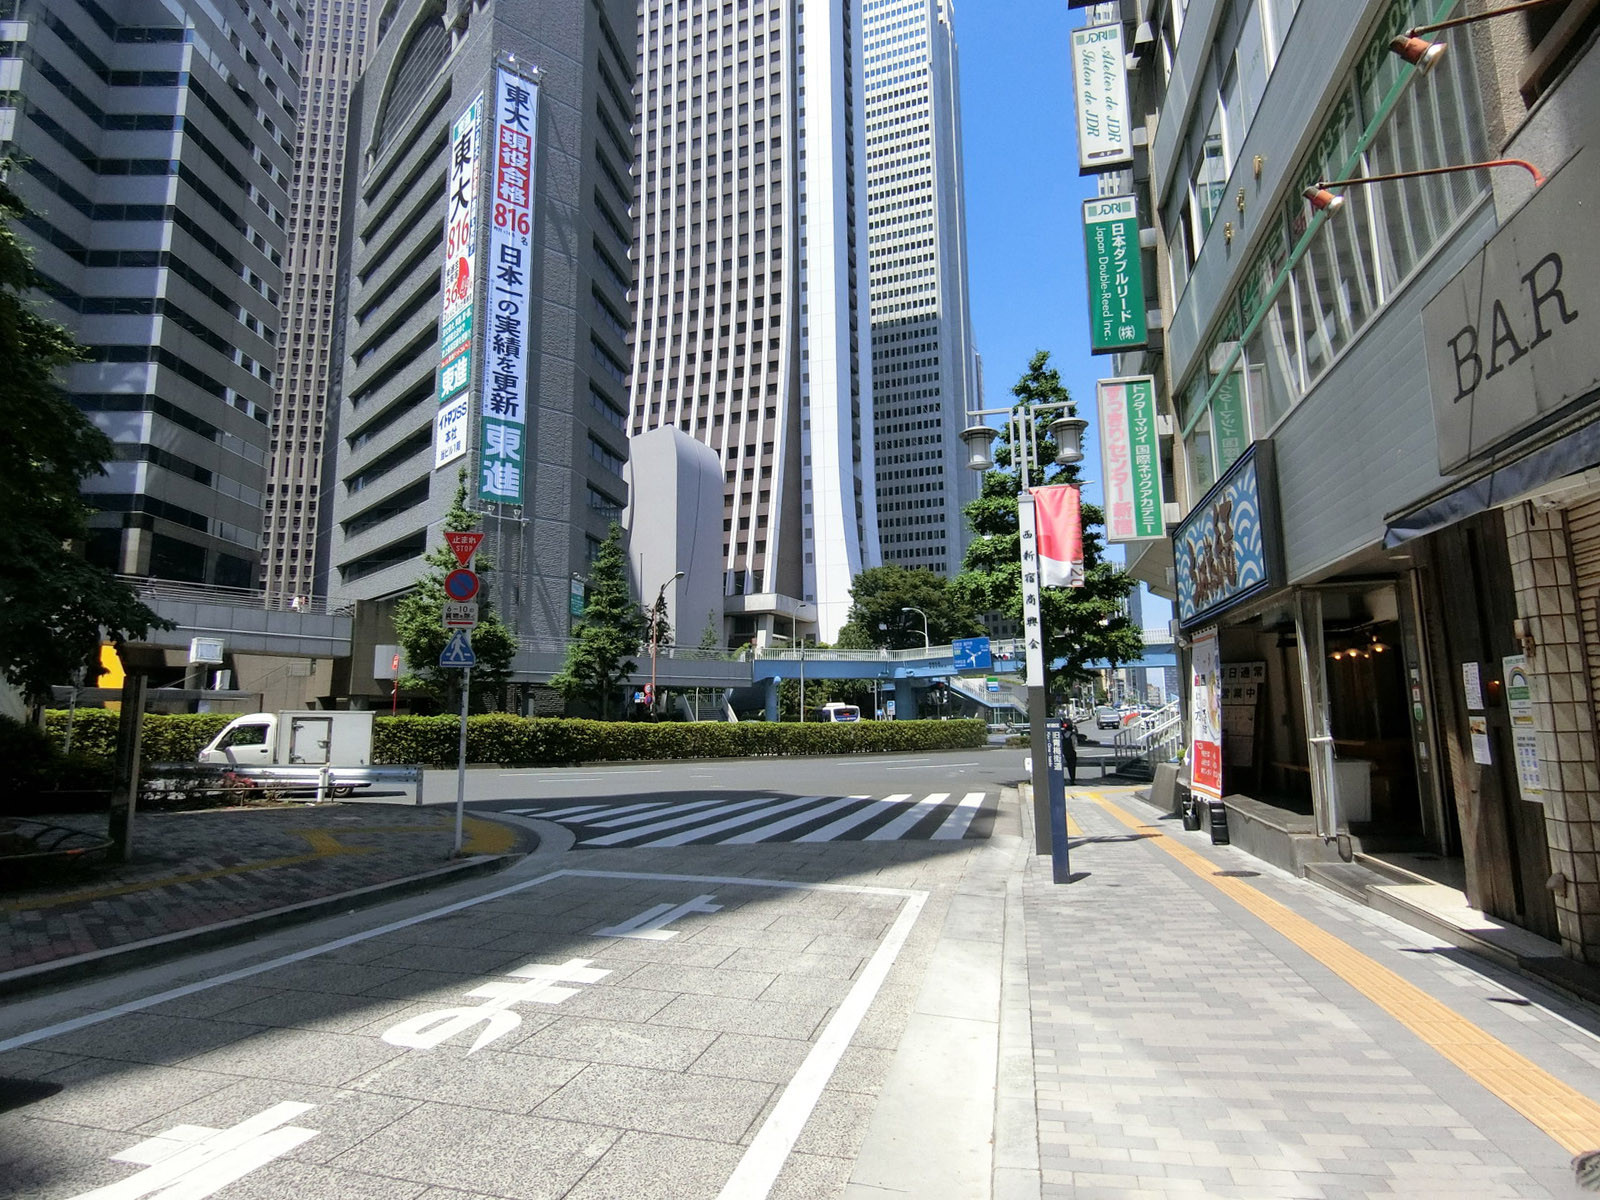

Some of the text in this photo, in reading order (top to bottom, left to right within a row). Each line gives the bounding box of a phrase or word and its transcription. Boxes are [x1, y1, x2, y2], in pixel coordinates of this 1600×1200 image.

[504, 82, 530, 132] 東大
[1084, 90, 1098, 102] de
[1086, 109, 1101, 137] JDR
[1101, 45, 1122, 143] Atelier de JDR
[451, 126, 472, 223] 東大
[501, 131, 529, 206] 現役合格
[448, 211, 469, 259] 816
[494, 203, 530, 236] 816
[1097, 202, 1121, 216] JDRI
[1095, 226, 1114, 341] Japan Double-Reed Inc.
[491, 244, 523, 417] 日本一の実績を更新
[1447, 252, 1579, 404] BAR
[441, 355, 468, 397] 東進
[483, 423, 521, 498] 東進
[452, 536, 477, 544] 止まれ
[1022, 529, 1040, 650] 西新宿商興会
